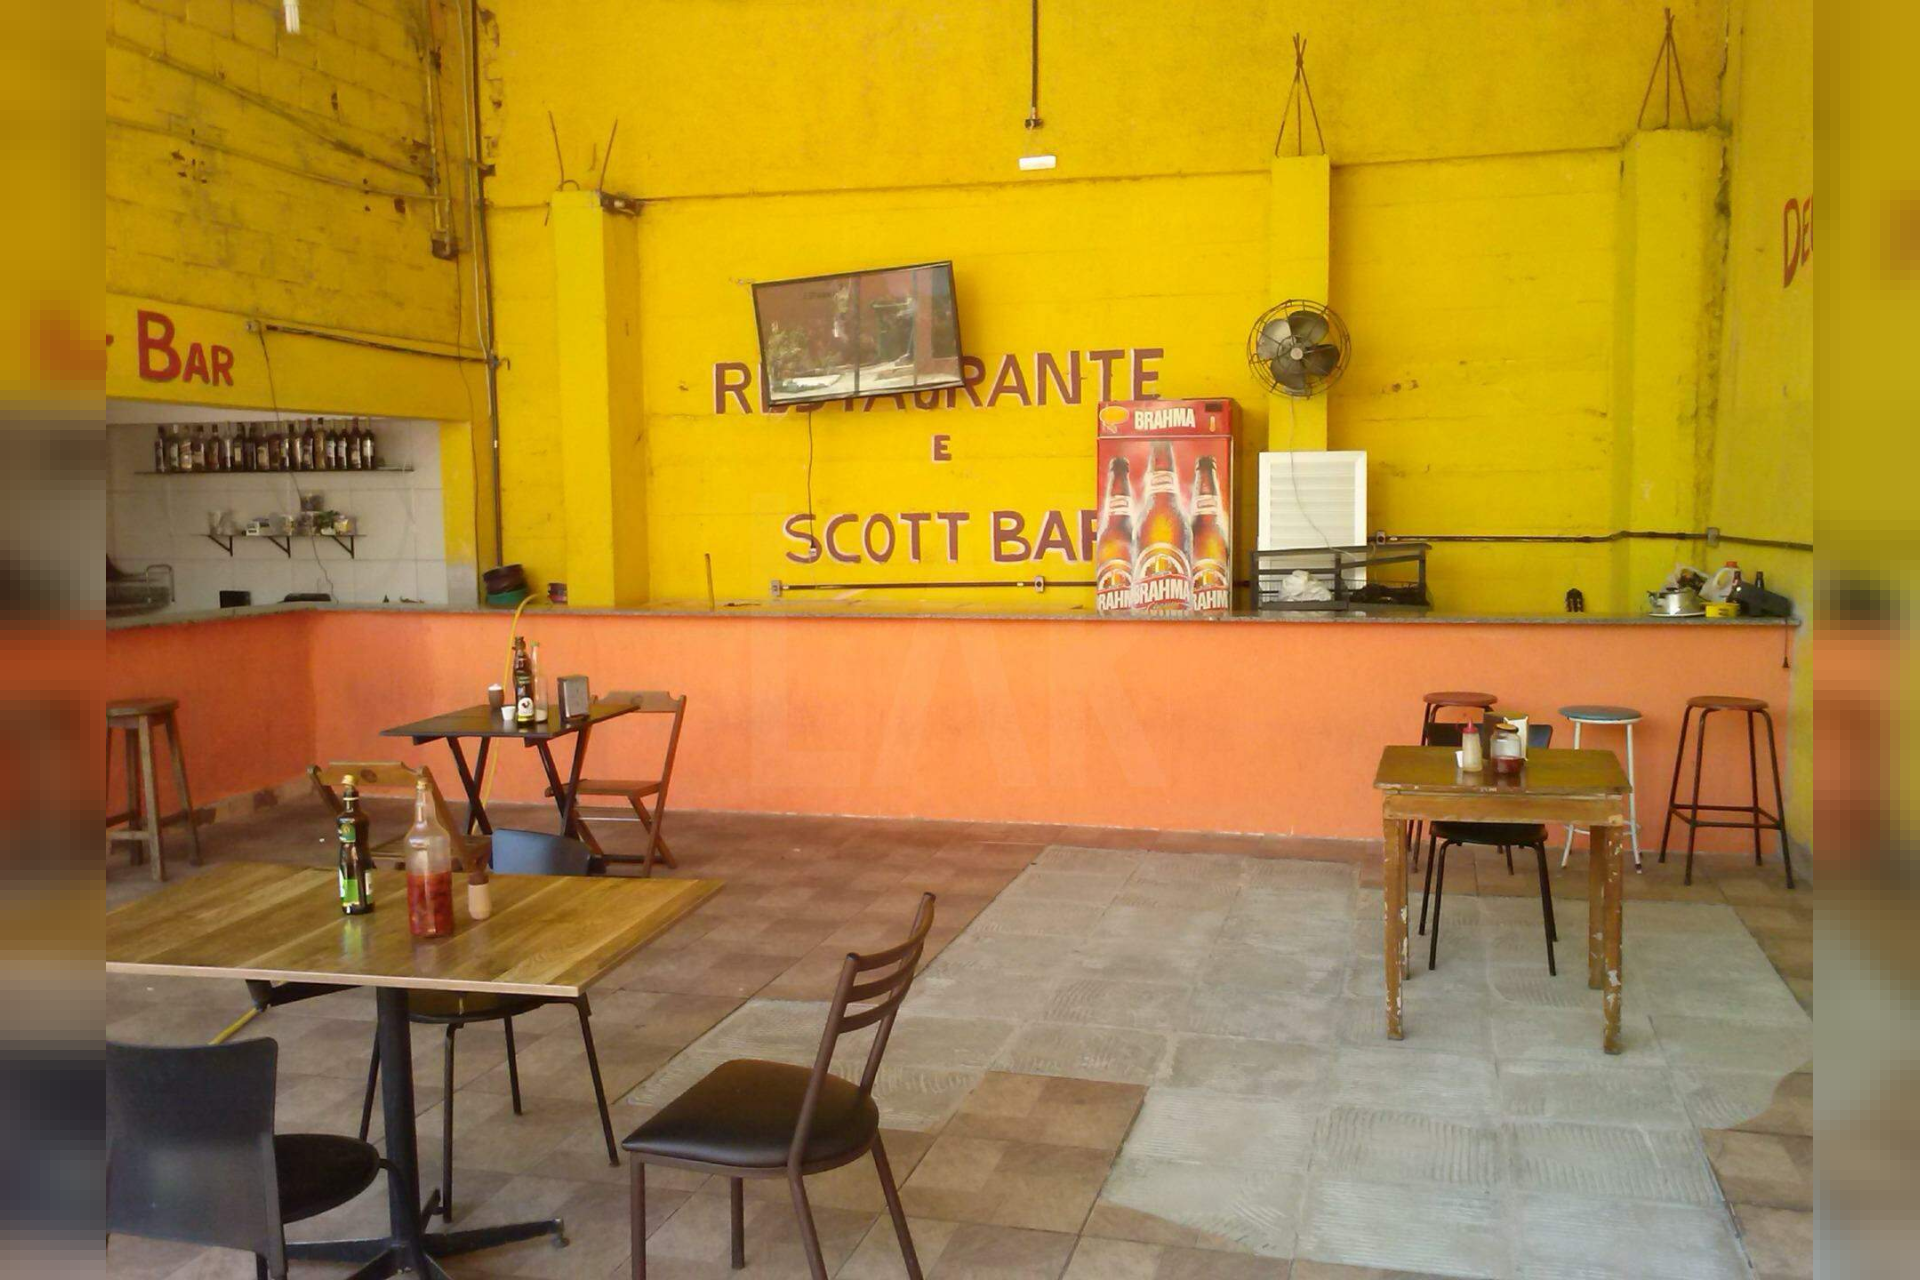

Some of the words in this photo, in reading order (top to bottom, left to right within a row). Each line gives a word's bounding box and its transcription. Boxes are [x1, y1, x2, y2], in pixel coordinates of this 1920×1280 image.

[1783, 193, 1813, 288] DE
[714, 347, 1164, 415] RRANTE
[1134, 407, 1196, 431] BRAHMA
[931, 434, 952, 462] E
[784, 512, 970, 563] SCOTT
